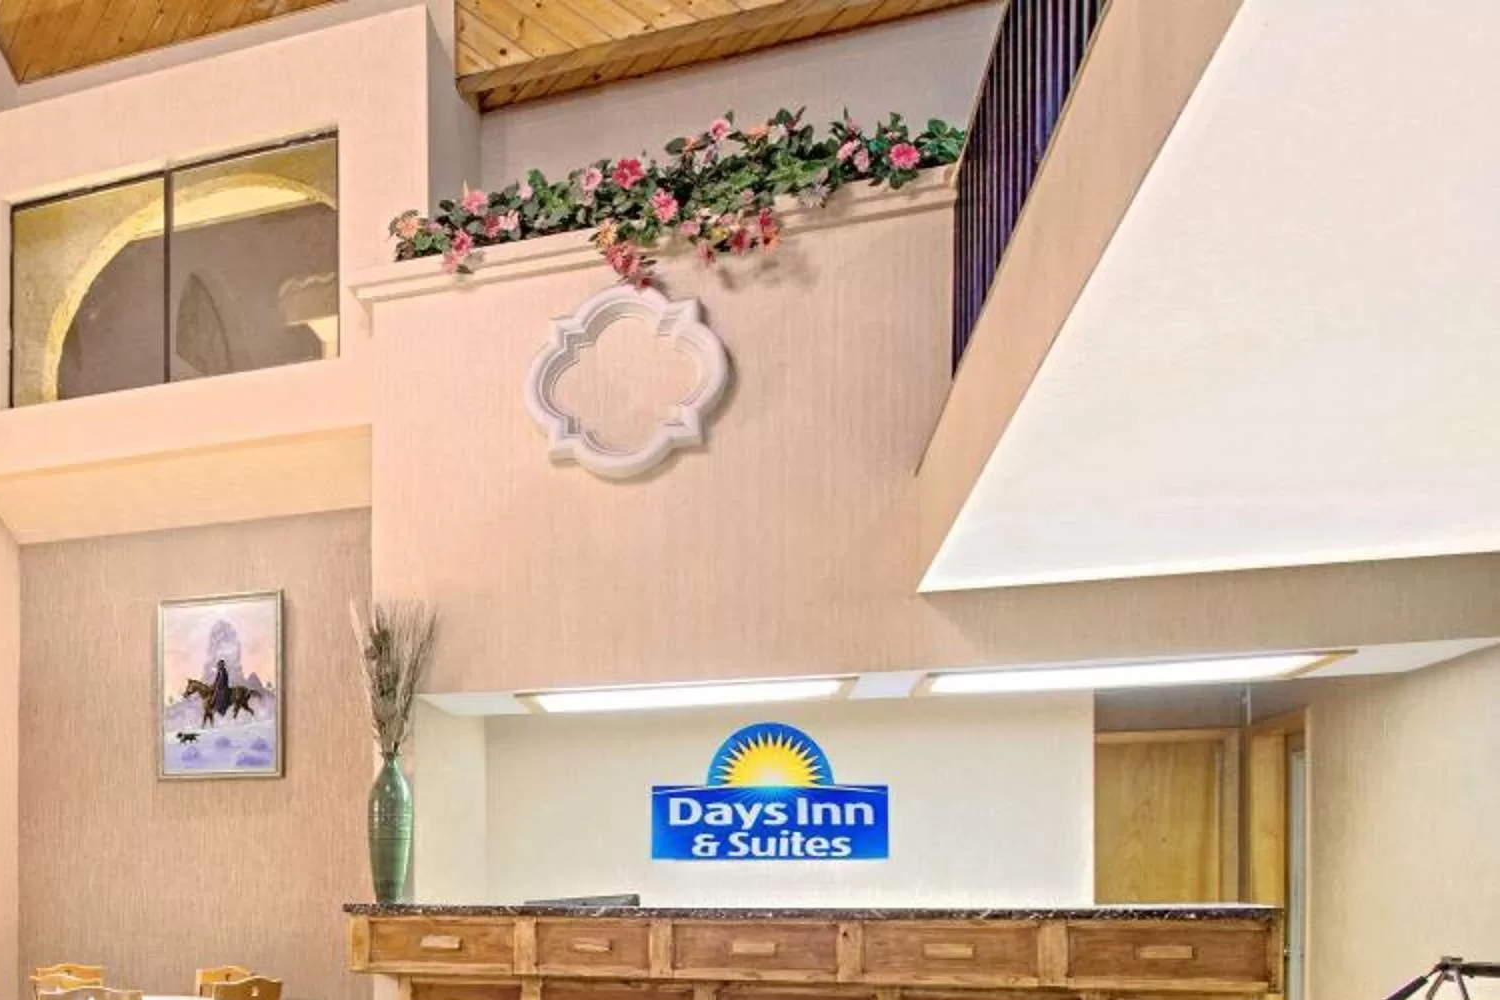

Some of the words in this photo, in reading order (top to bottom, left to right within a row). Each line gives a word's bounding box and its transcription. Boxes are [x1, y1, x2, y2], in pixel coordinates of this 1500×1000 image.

[668, 797, 787, 830] Days
[797, 797, 875, 825] Inn
[691, 833, 720, 857] &
[728, 830, 852, 857] Suites
